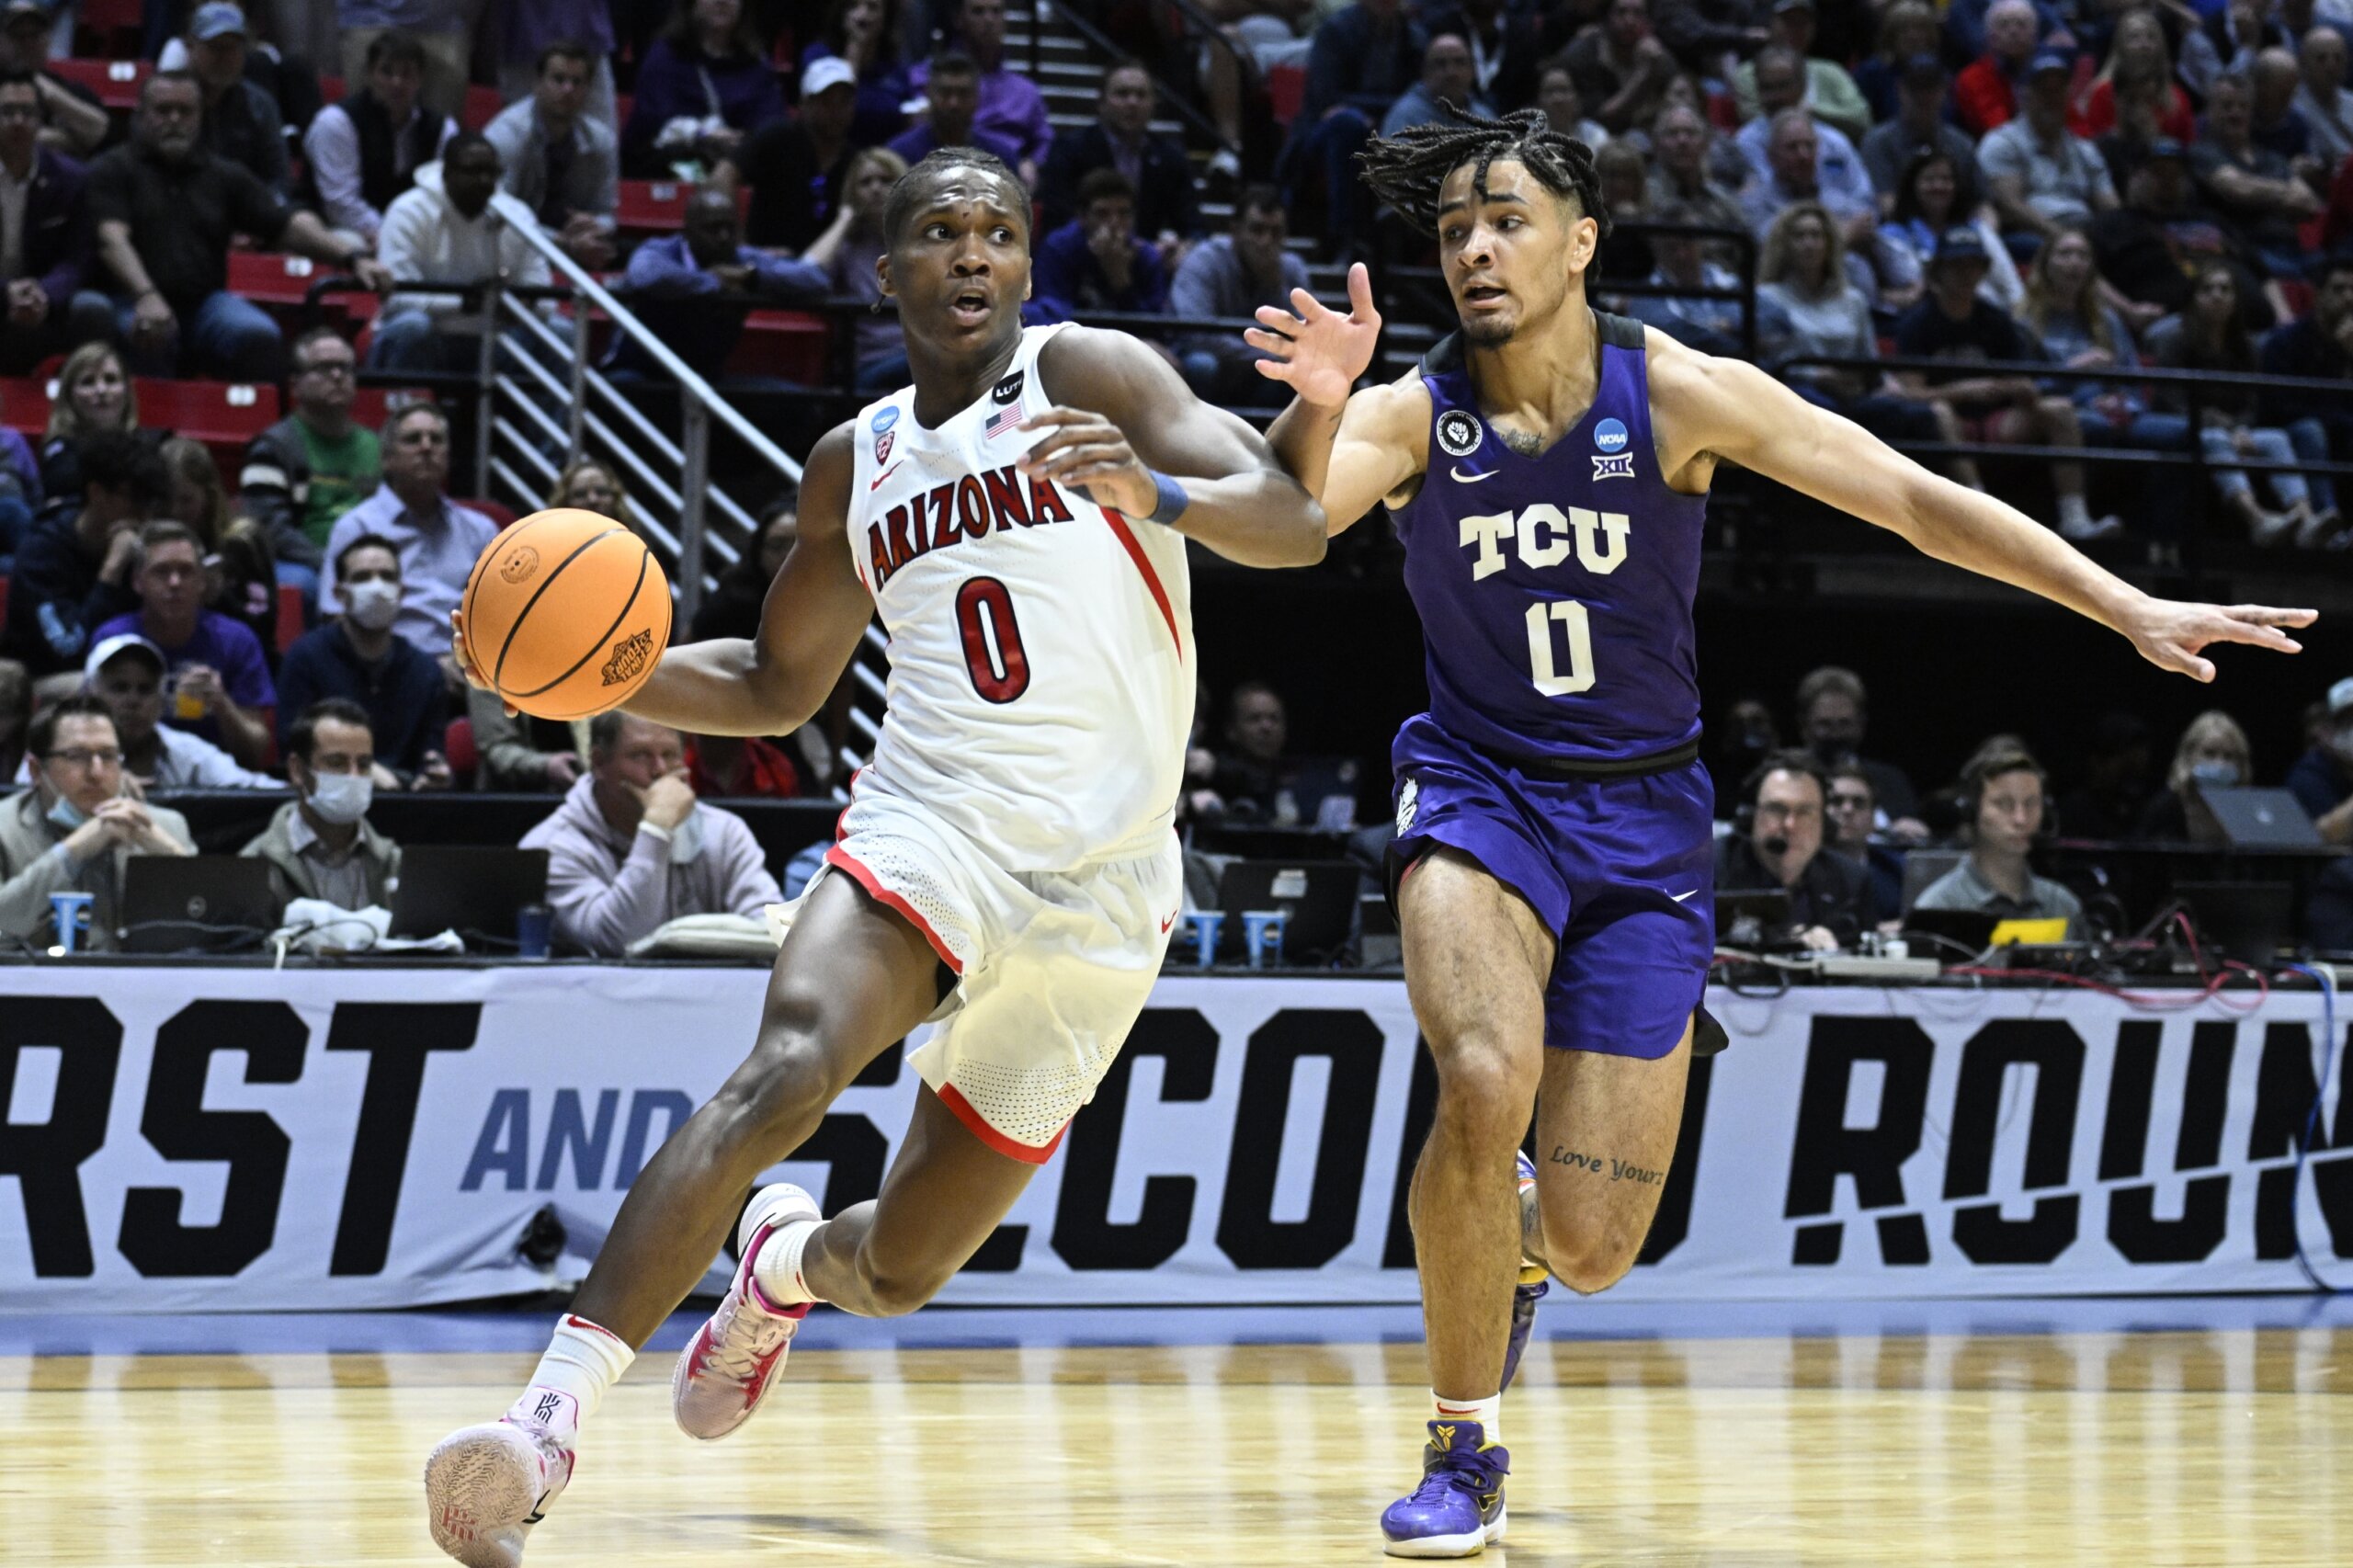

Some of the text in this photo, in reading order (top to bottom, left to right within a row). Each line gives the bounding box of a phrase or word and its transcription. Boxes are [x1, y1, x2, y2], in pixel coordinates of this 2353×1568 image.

[1598, 433, 1627, 446] NCAA
[868, 464, 1074, 593] ARIZONA
[1460, 504, 1631, 581] TCU
[613, 637, 642, 676] FOUR
[620, 648, 647, 682] FINAL
[956, 575, 1030, 704] 0
[1526, 599, 1596, 697] 0
[0, 994, 483, 1278] RST
[459, 1088, 694, 1191] AND
[1783, 1015, 2353, 1266] ROUN
[1550, 1145, 1602, 1172] Love
